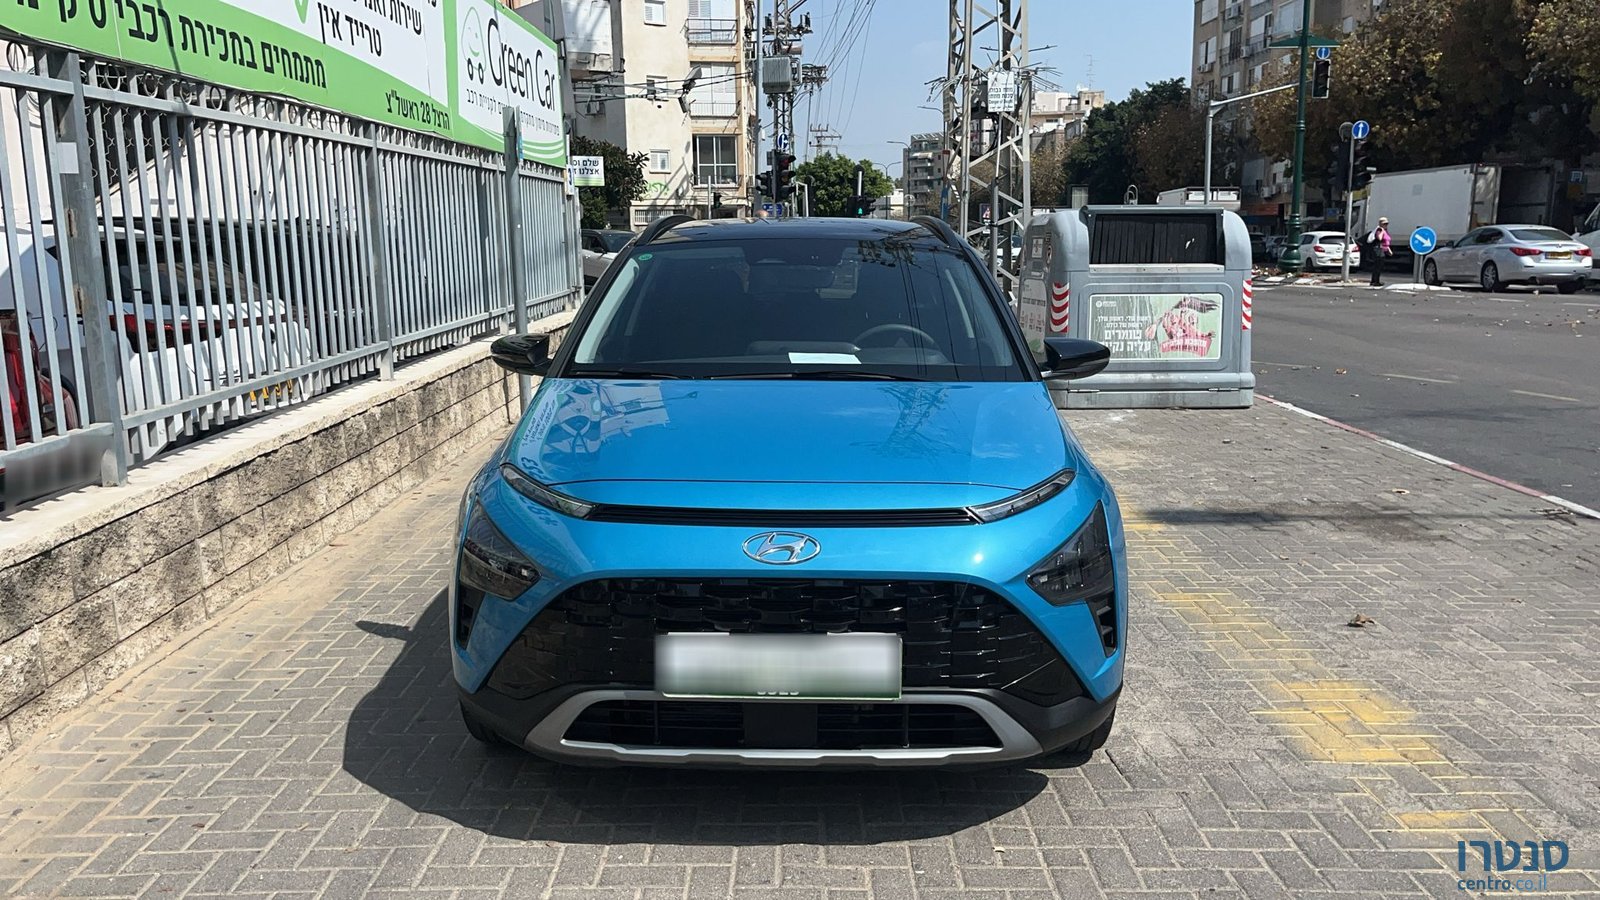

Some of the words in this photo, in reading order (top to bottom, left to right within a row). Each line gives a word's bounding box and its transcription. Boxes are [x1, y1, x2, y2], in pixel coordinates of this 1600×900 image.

[116, 0, 174, 48] רכבי
[178, 15, 257, 69] במכירת
[317, 2, 343, 44] אין
[344, 14, 382, 57] טרייד
[261, 41, 327, 88] מתמחים
[487, 18, 535, 101] Green
[535, 49, 555, 111] Car
[420, 100, 432, 124] 28
[431, 103, 450, 130] הרצל
[578, 167, 600, 175] אצלנו
[582, 158, 600, 167] שלם
[1126, 339, 1151, 352] עליה
